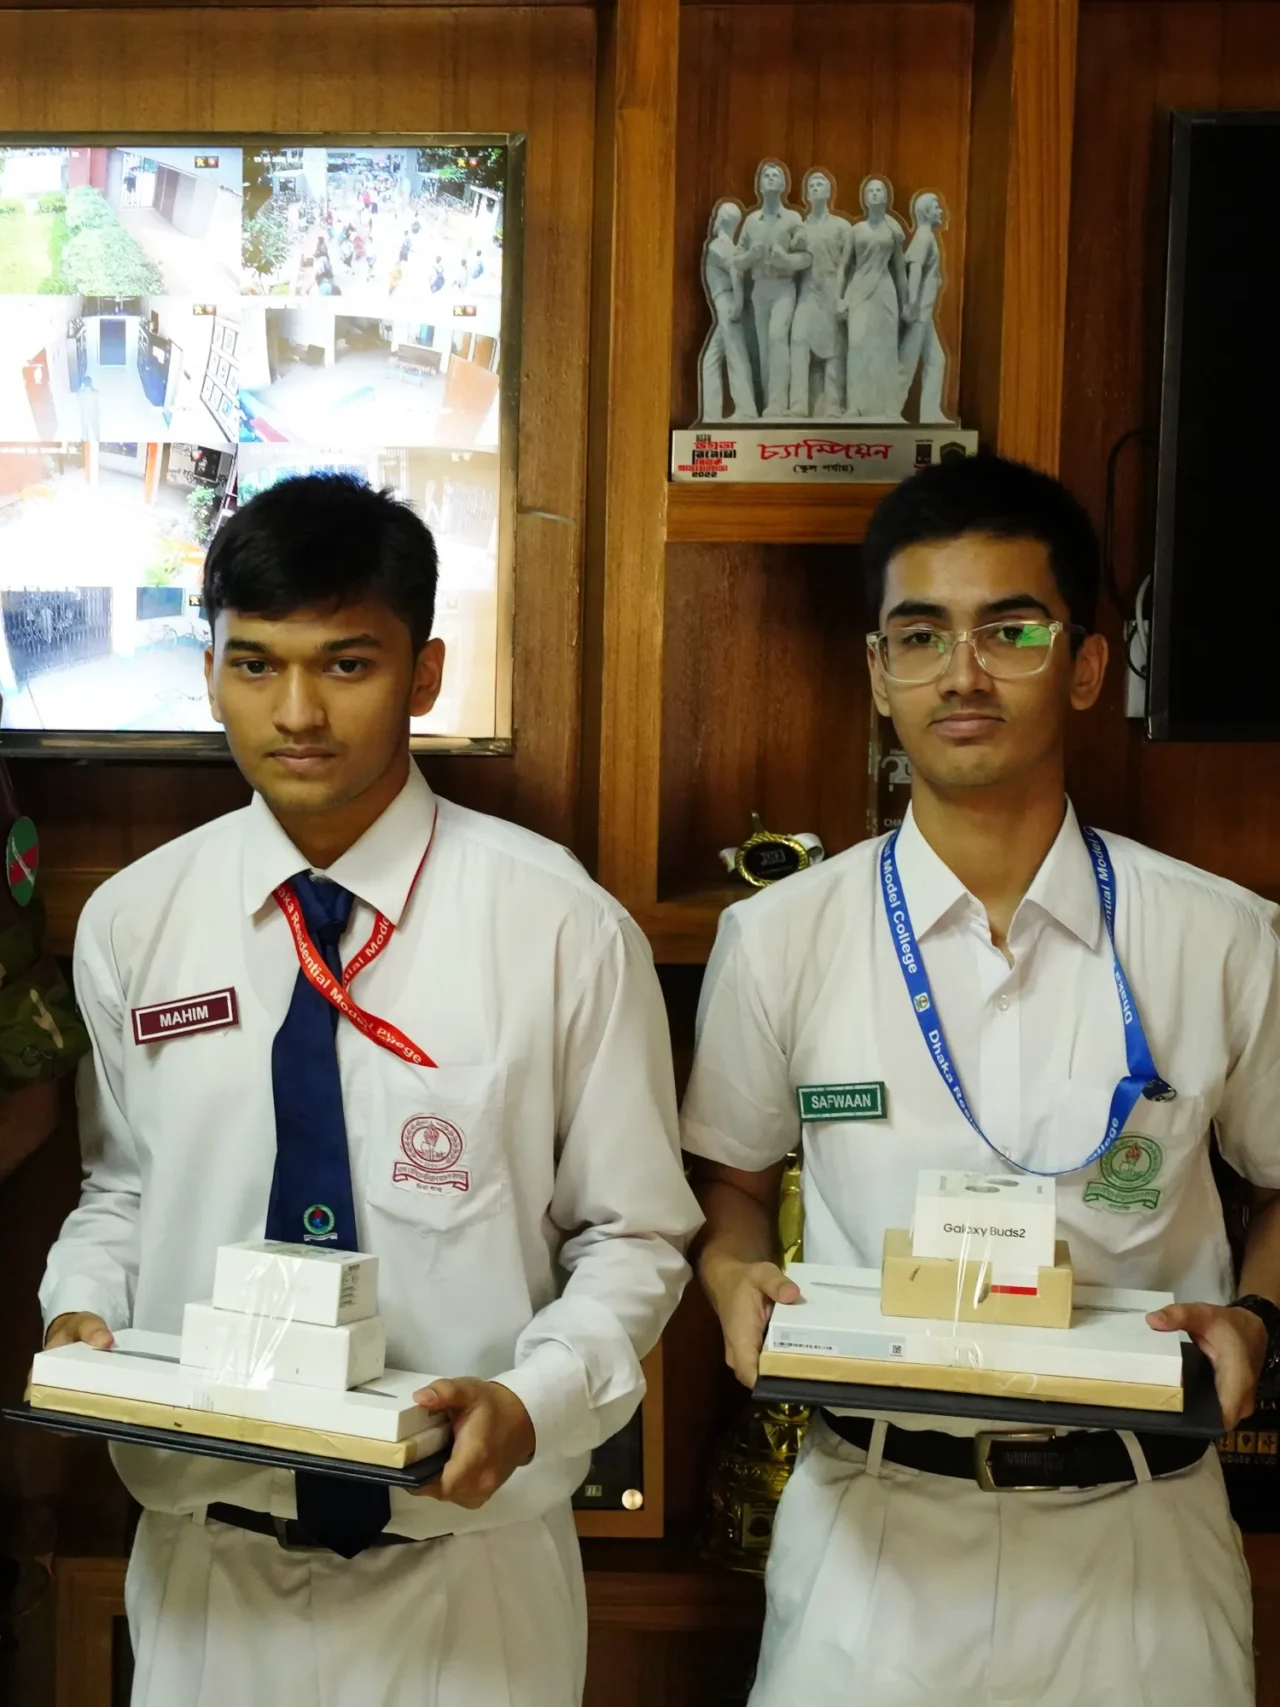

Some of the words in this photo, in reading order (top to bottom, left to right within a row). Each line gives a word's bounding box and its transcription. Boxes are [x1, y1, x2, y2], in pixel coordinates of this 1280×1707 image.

[757, 438, 893, 460] চ্যাম্পিয়ন
[883, 859, 902, 908] Model
[893, 910, 918, 974] College
[291, 911, 332, 989] Residential
[159, 1005, 210, 1028] MAHIM
[928, 1029, 954, 1084] Dhaka
[810, 1093, 872, 1110] SAFWAAN
[943, 1221, 988, 1238] Galaxy
[989, 1226, 1026, 1239] Buds2
